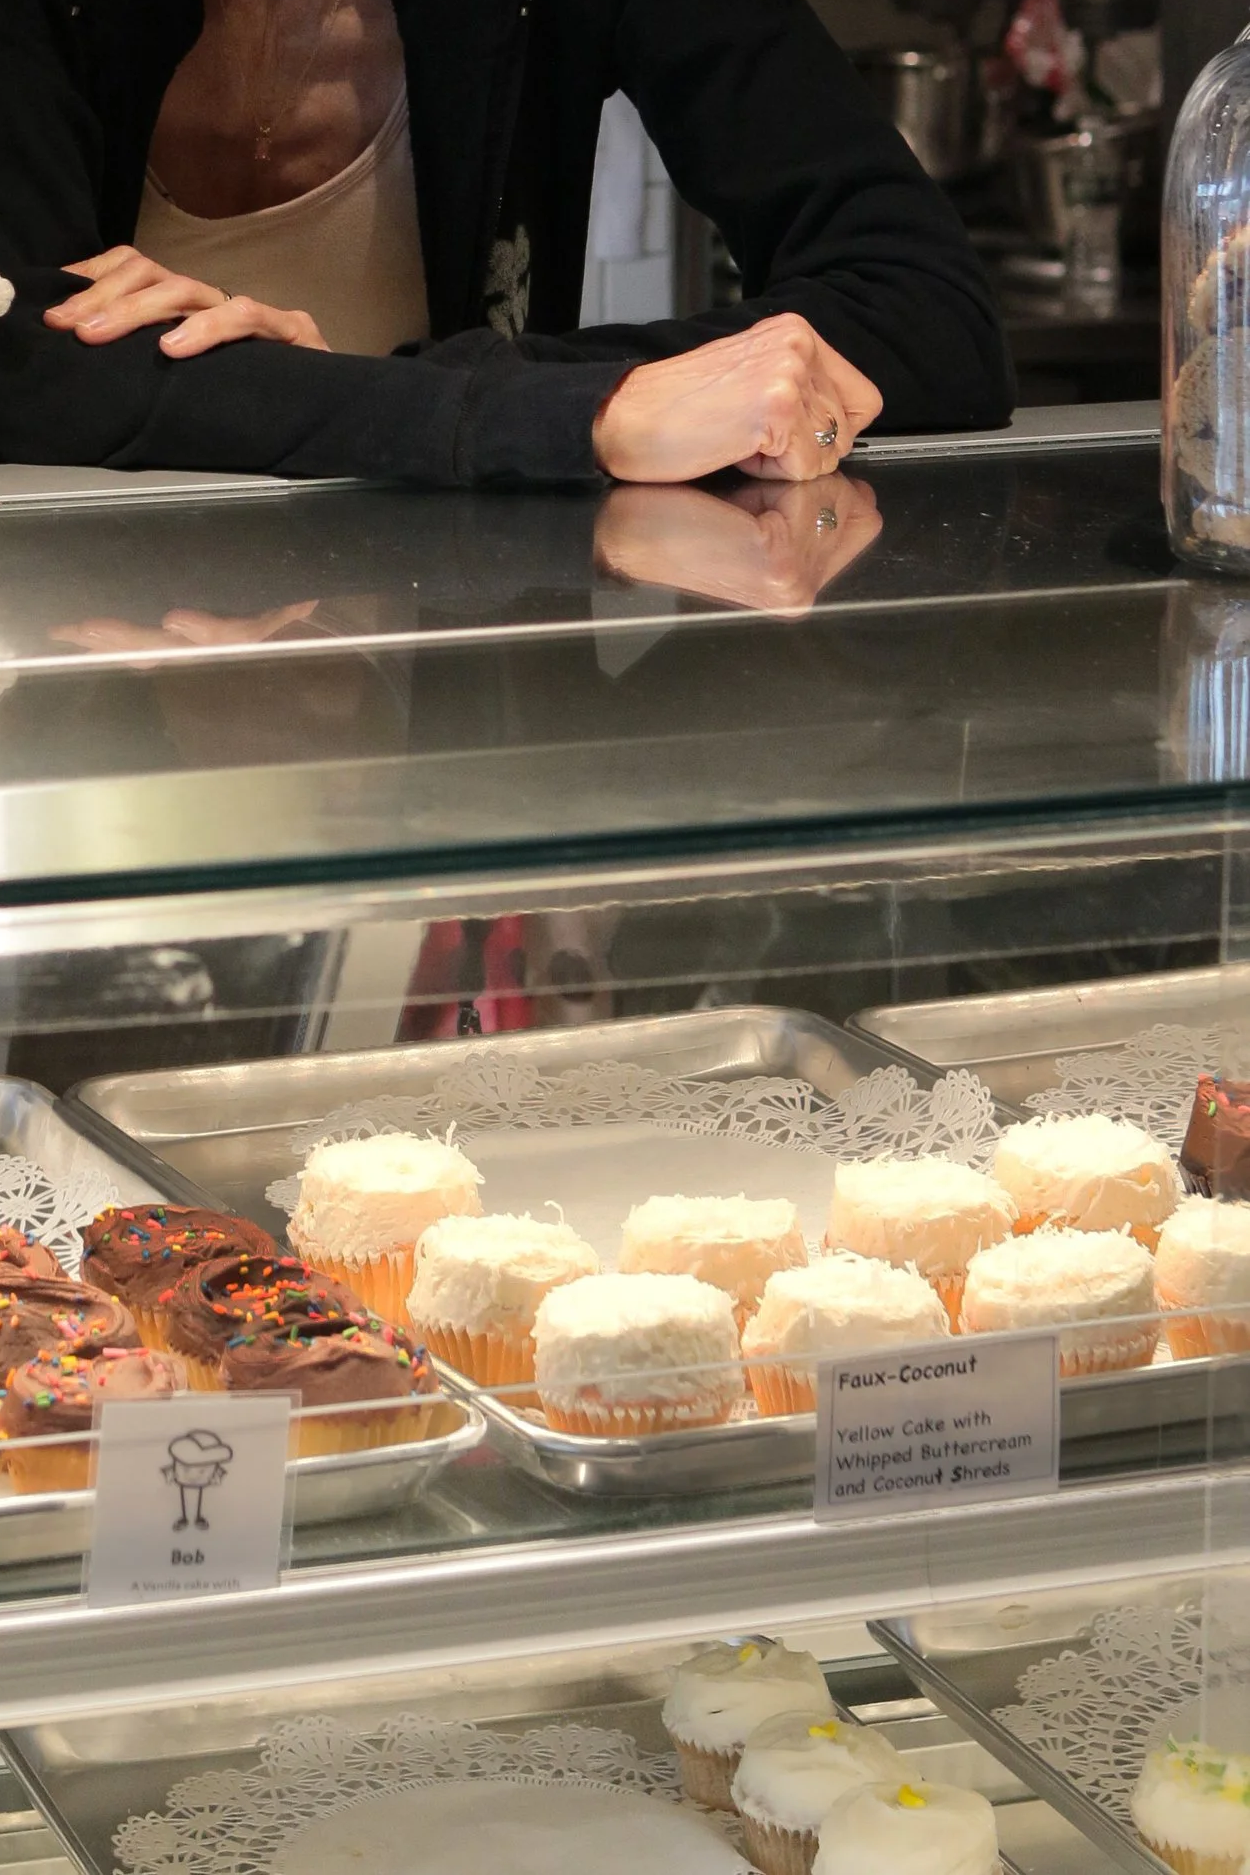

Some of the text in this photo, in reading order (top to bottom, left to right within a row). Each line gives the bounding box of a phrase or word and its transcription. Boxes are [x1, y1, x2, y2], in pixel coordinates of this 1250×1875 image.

[838, 1354, 978, 1390] Faux-Coconut
[837, 1410, 992, 1444] Yellow Cake with
[836, 1434, 1032, 1471] Whipped Buttercream
[835, 1461, 1011, 1497] and Coconut Shreds
[171, 1547, 205, 1566] Bob
